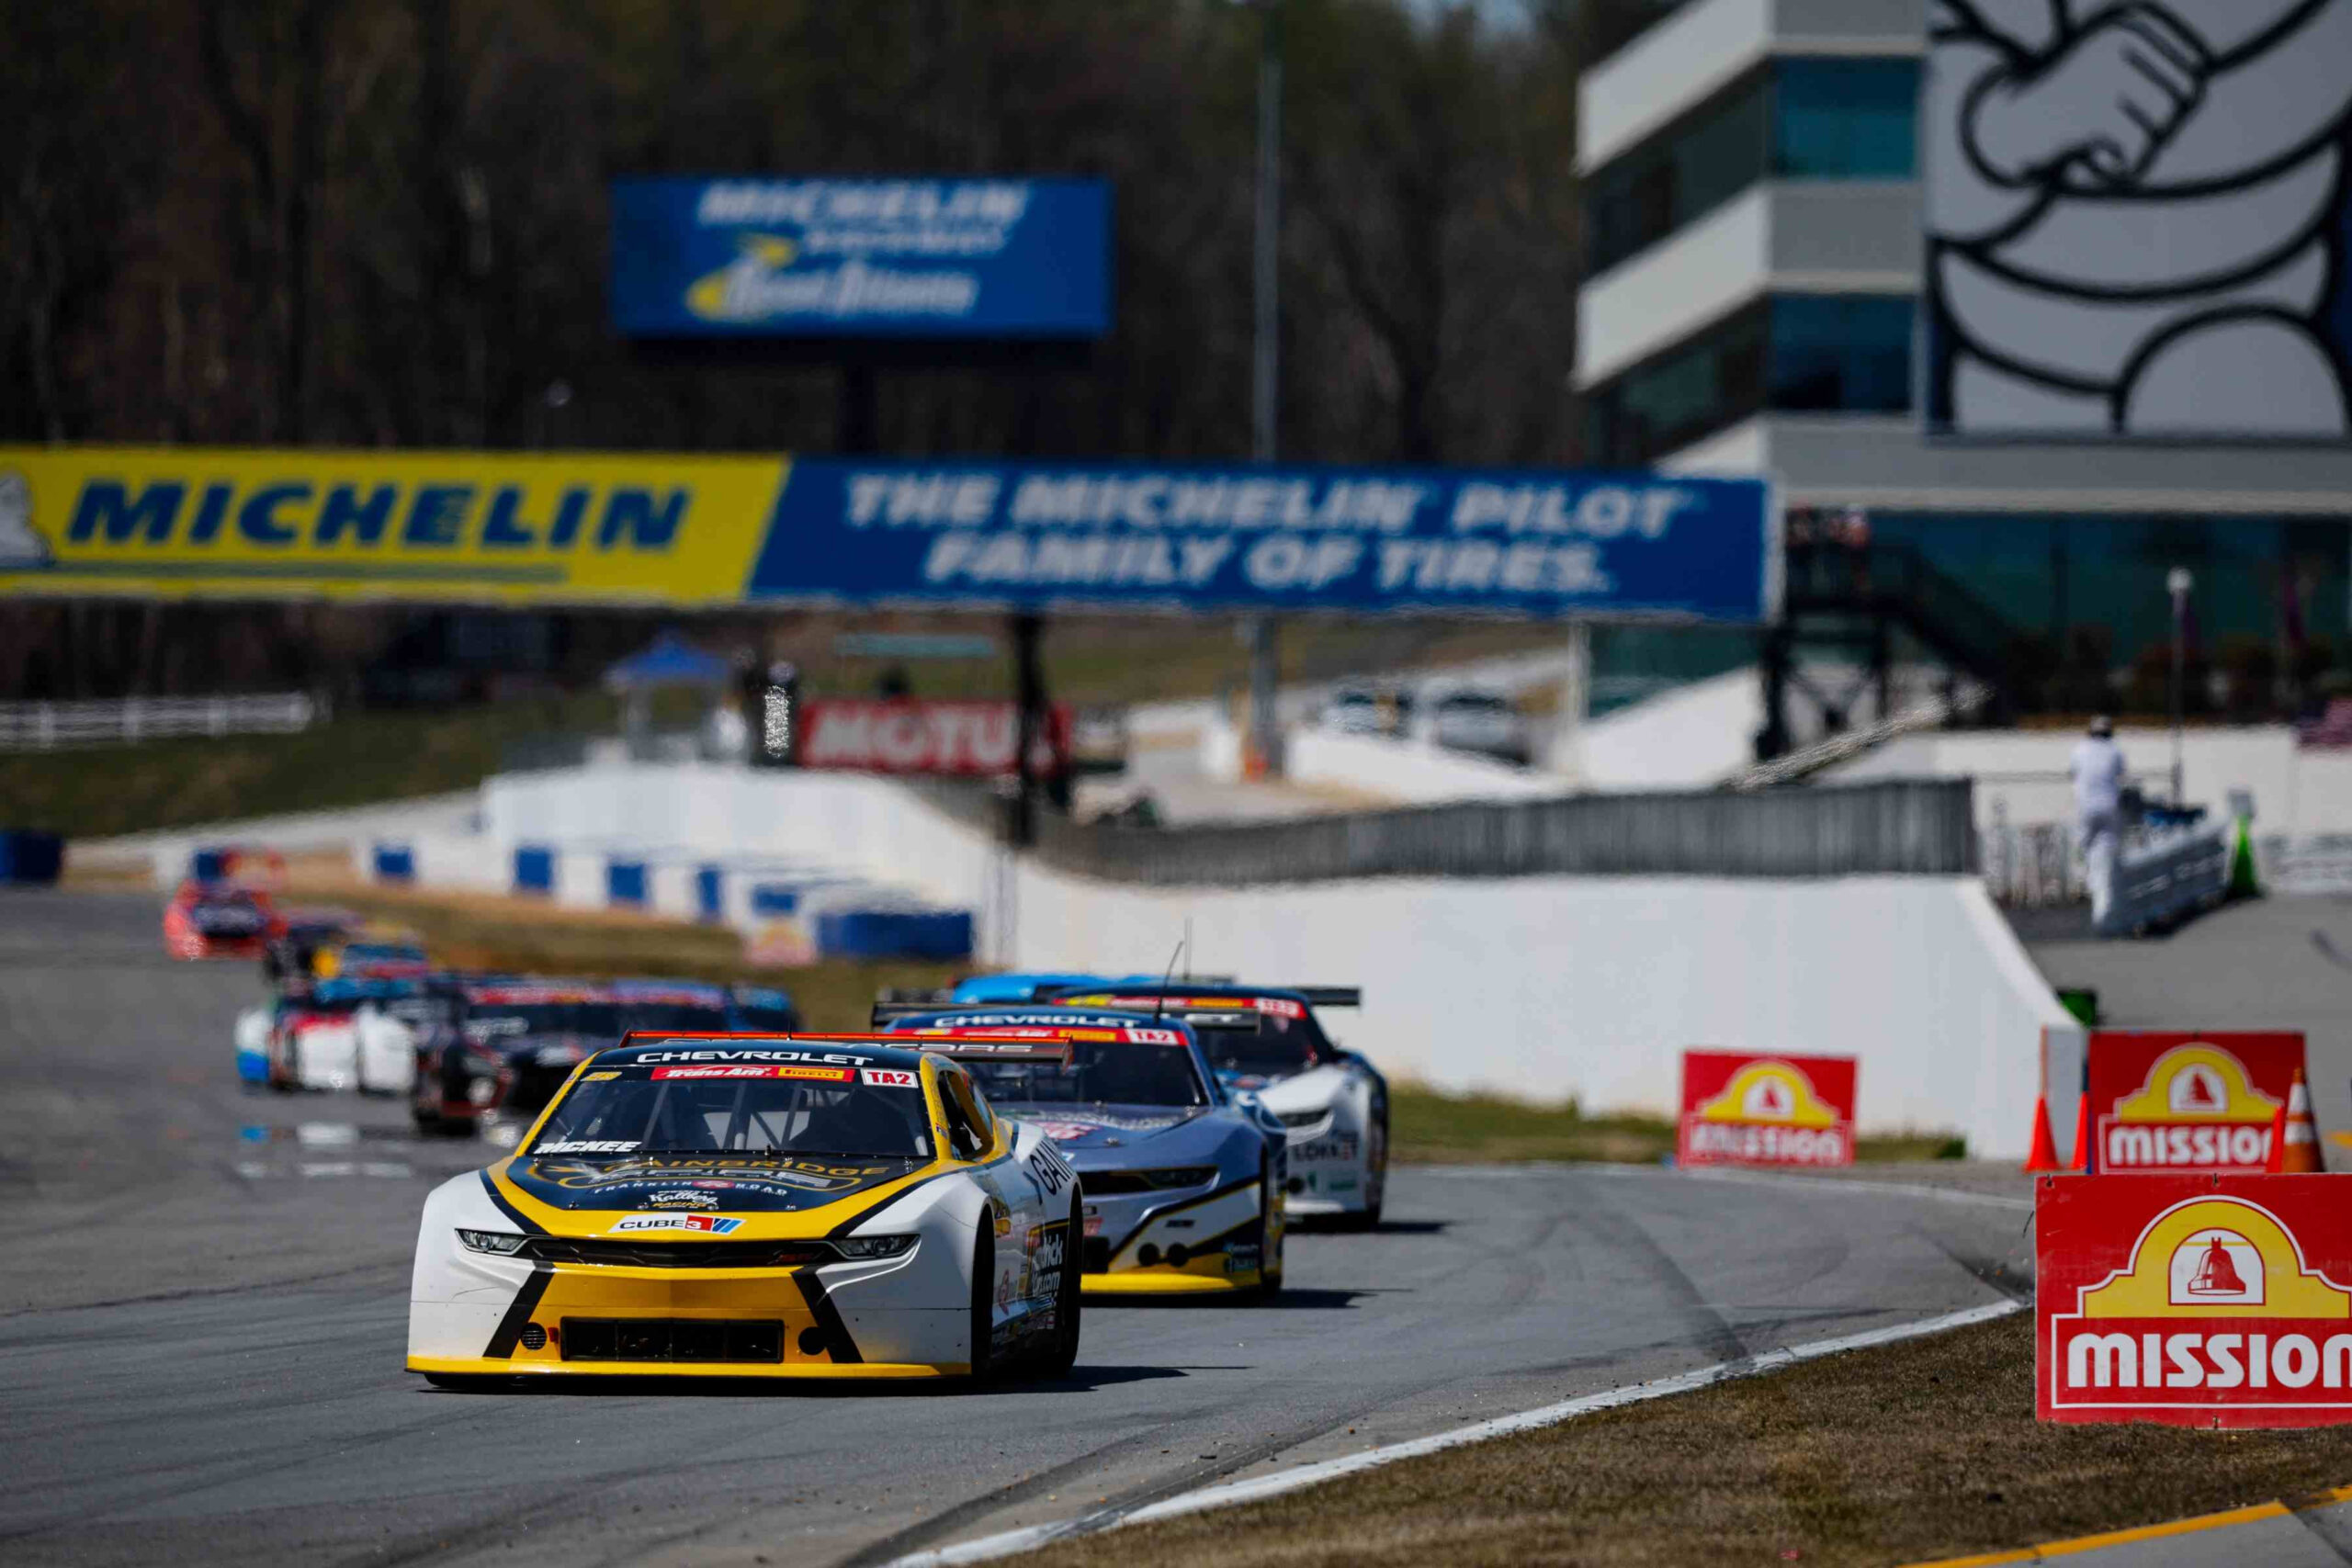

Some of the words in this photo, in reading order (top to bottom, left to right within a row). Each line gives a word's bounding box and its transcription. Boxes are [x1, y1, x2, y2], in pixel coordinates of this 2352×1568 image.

[66, 479, 689, 551] MICHELIN
[845, 472, 1000, 527] THE
[1009, 474, 1422, 533] MICHELIN
[1453, 481, 1683, 537] PILOT
[924, 533, 1237, 588] FAMILY
[1245, 533, 1363, 590] OF
[934, 1014, 1142, 1029] CHEVROLET
[637, 1050, 874, 1066] CHEVROLET
[871, 1070, 911, 1085] TA2
[533, 1140, 642, 1155] MCKEE
[2067, 1332, 2352, 1388] MISSION
